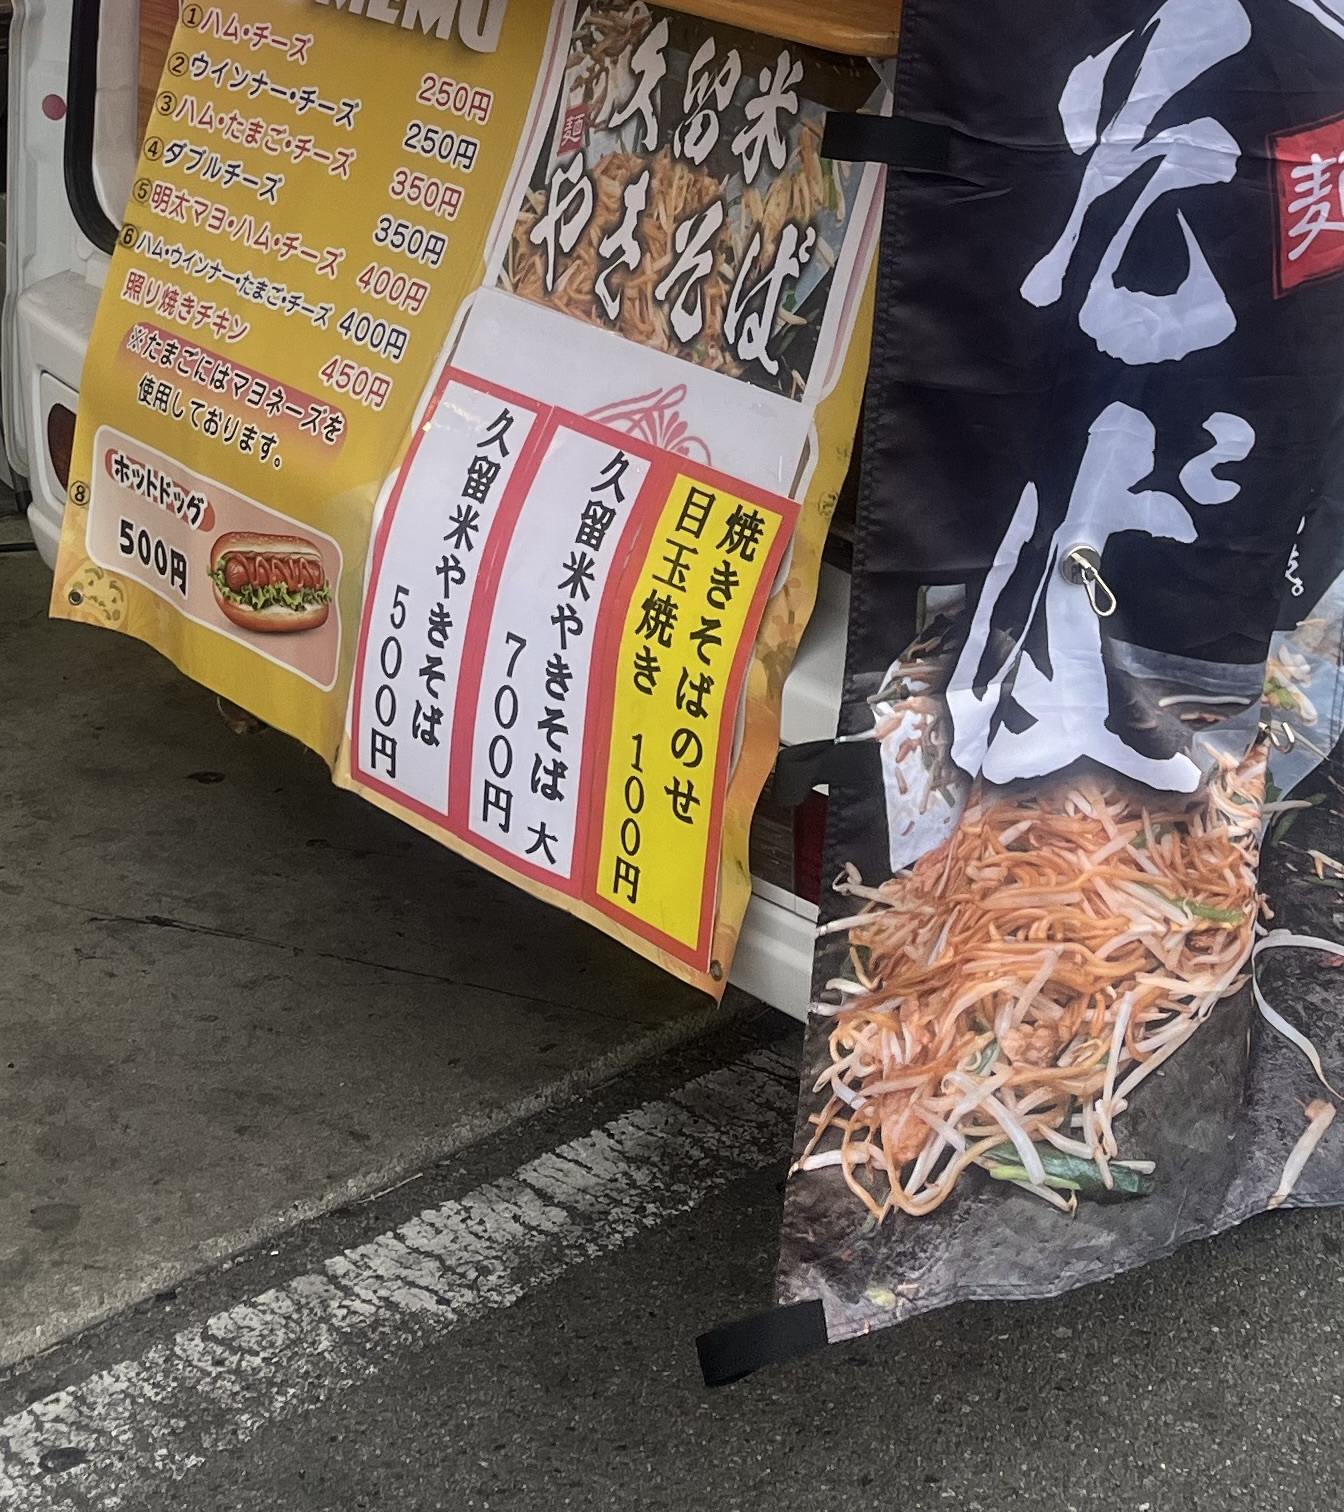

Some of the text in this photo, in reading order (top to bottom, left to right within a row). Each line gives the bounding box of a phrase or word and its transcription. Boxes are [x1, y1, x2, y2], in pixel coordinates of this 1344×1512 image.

[417, 73, 494, 124] 250円
[402, 121, 479, 172] 250円
[389, 169, 464, 219] 350円
[372, 216, 447, 267] 350円
[122, 270, 251, 344] 照り焼きチキン
[356, 263, 431, 314] 400円
[337, 310, 409, 361] 400円
[319, 355, 394, 410] 450円
[137, 372, 283, 470] 使用しております。
[112, 452, 207, 527] ホットドッグ
[119, 518, 190, 598] 500円
[410, 407, 515, 749] 久留米やきそば
[529, 450, 626, 803] 久留米やきそば
[663, 502, 765, 825] 焼きそばのせ
[369, 583, 411, 780] 500円
[612, 485, 718, 905] 目玉焼き 100円
[481, 632, 528, 834] 700円
